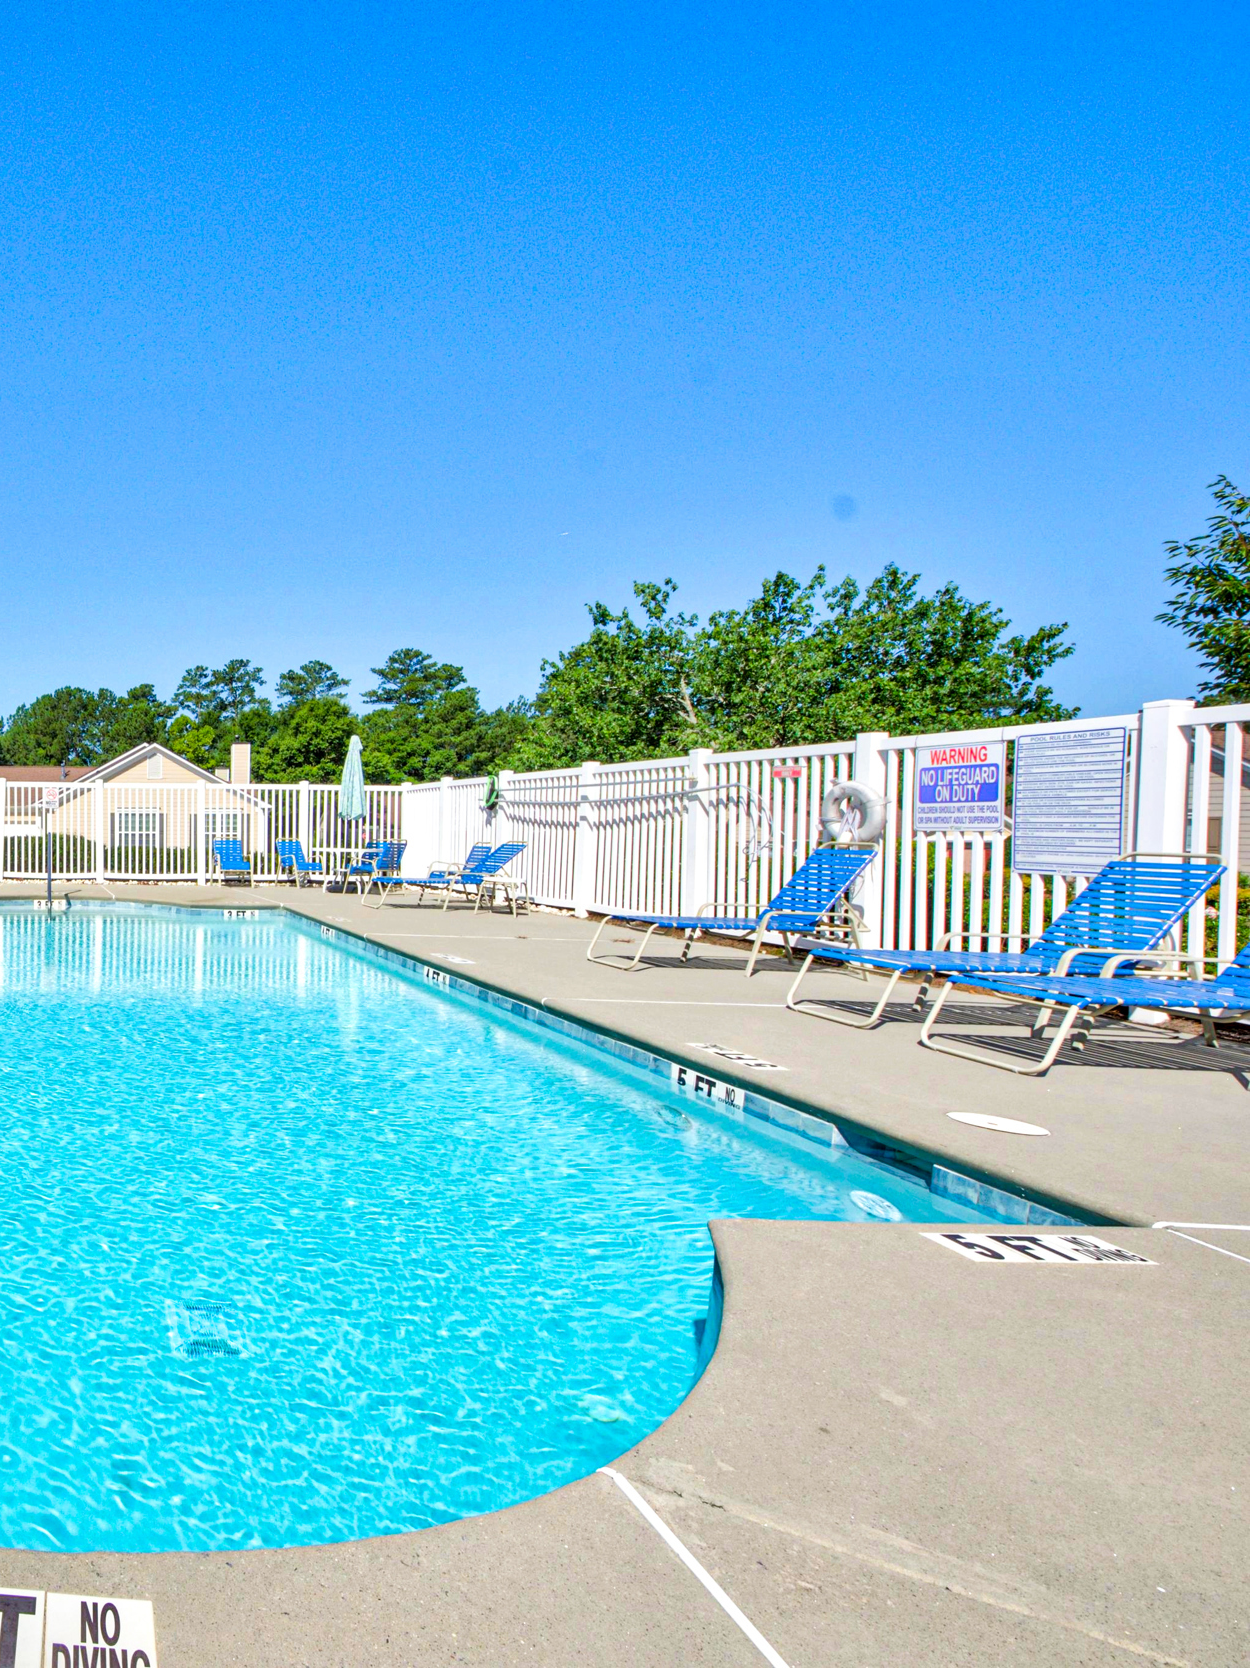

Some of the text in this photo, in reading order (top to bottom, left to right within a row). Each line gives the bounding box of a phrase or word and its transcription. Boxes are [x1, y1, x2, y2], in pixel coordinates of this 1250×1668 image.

[930, 746, 988, 765] WARNING
[921, 766, 997, 786] NO LIFEGUARD
[935, 784, 982, 802] ON DUTY
[918, 804, 999, 814] CHILDREN SHOULD NOT USE THE POOL
[918, 815, 999, 824] OR SPA WITHOUT ADULT SUPERVISION
[677, 1067, 717, 1098] 5 FT
[725, 1086, 736, 1103] NO
[940, 1233, 1079, 1261] 5 FT
[80, 1601, 121, 1646] NO
